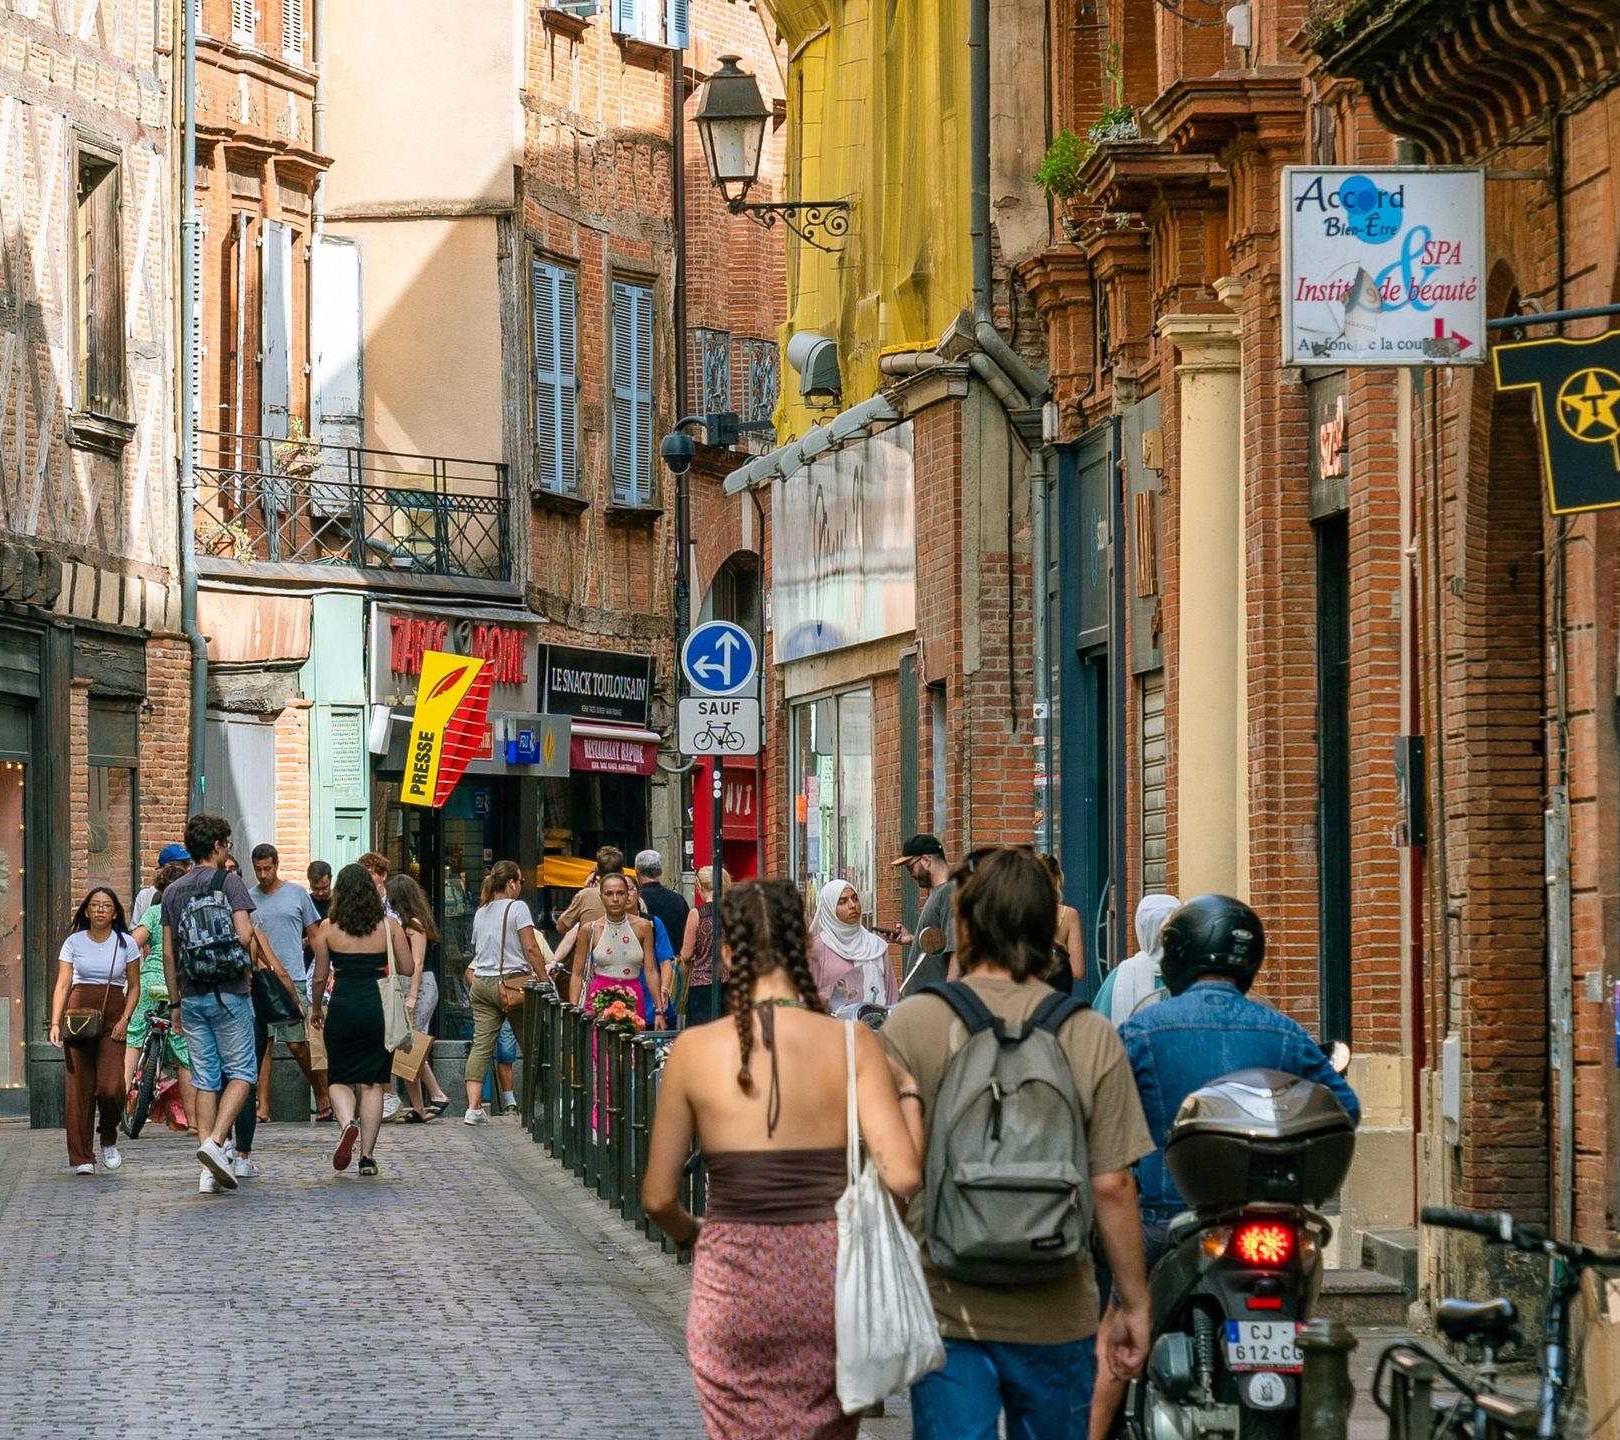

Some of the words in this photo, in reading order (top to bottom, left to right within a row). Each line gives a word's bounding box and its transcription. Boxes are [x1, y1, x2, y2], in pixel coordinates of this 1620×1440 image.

[1294, 175, 1405, 212] Accord
[1420, 240, 1462, 266] SPA
[1380, 276, 1401, 302] de
[1407, 275, 1477, 302] beauté
[1397, 339, 1423, 351] cou
[551, 666, 564, 691] LE
[563, 667, 591, 695] SNACK
[592, 671, 647, 702] TOULOUSAIN
[697, 701, 741, 716] SAUF
[409, 730, 436, 796] PRESSE
